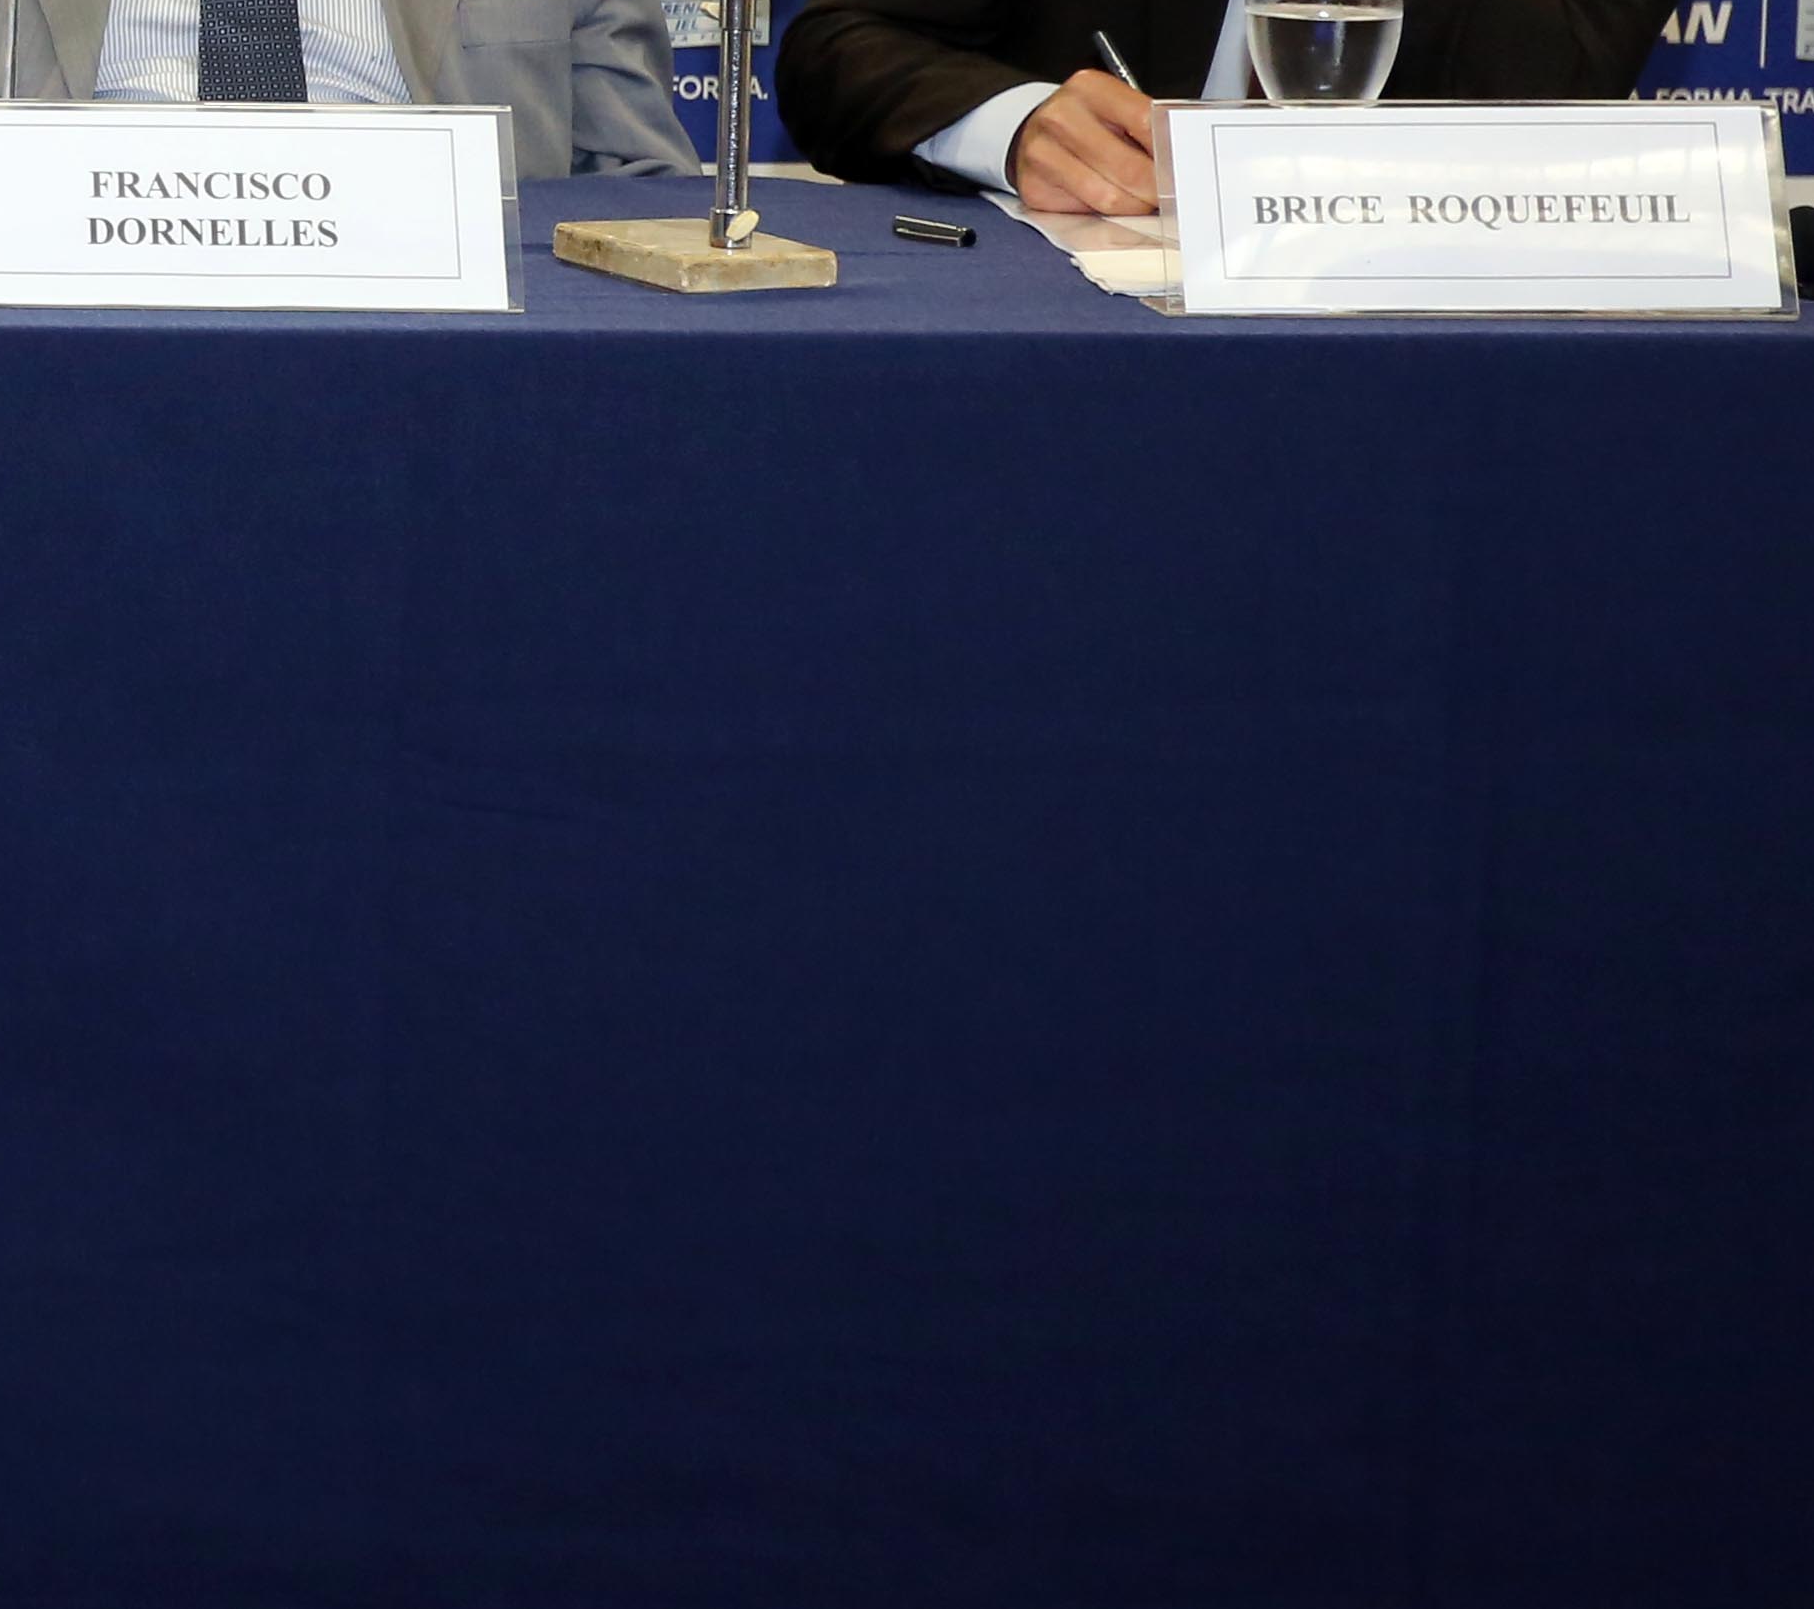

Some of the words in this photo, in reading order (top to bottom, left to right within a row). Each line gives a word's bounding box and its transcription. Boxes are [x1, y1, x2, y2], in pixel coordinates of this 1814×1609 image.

[90, 170, 332, 201] FRANCISCO
[1253, 195, 1384, 225] BRICE
[1407, 194, 1691, 231] ROQUEFEUIL
[87, 216, 339, 249] DORNELLES
